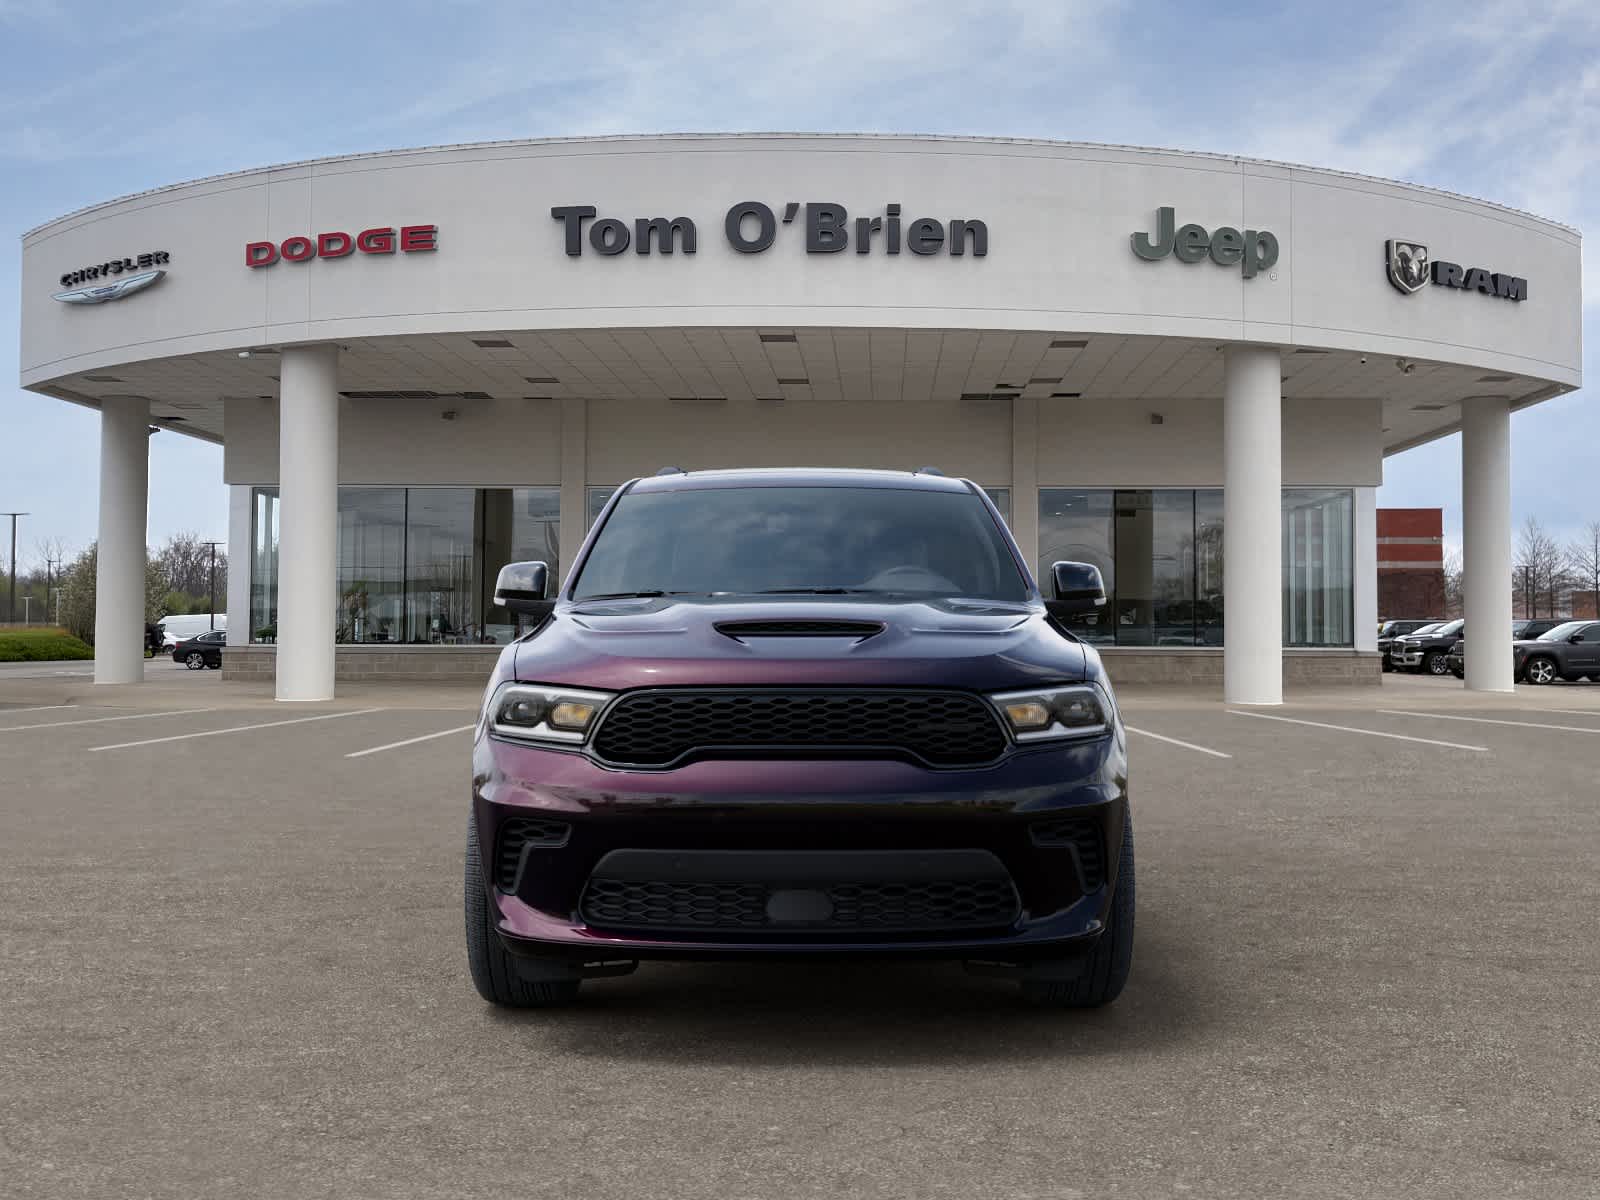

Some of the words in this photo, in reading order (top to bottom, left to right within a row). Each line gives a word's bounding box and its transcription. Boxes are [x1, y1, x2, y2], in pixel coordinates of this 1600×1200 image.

[245, 225, 438, 269] DODGE
[551, 205, 696, 256] Tom
[725, 201, 988, 256] O'Brien
[1130, 206, 1279, 279] Jeep
[60, 250, 170, 287] CHRYSLER
[1430, 260, 1528, 302] RAM
